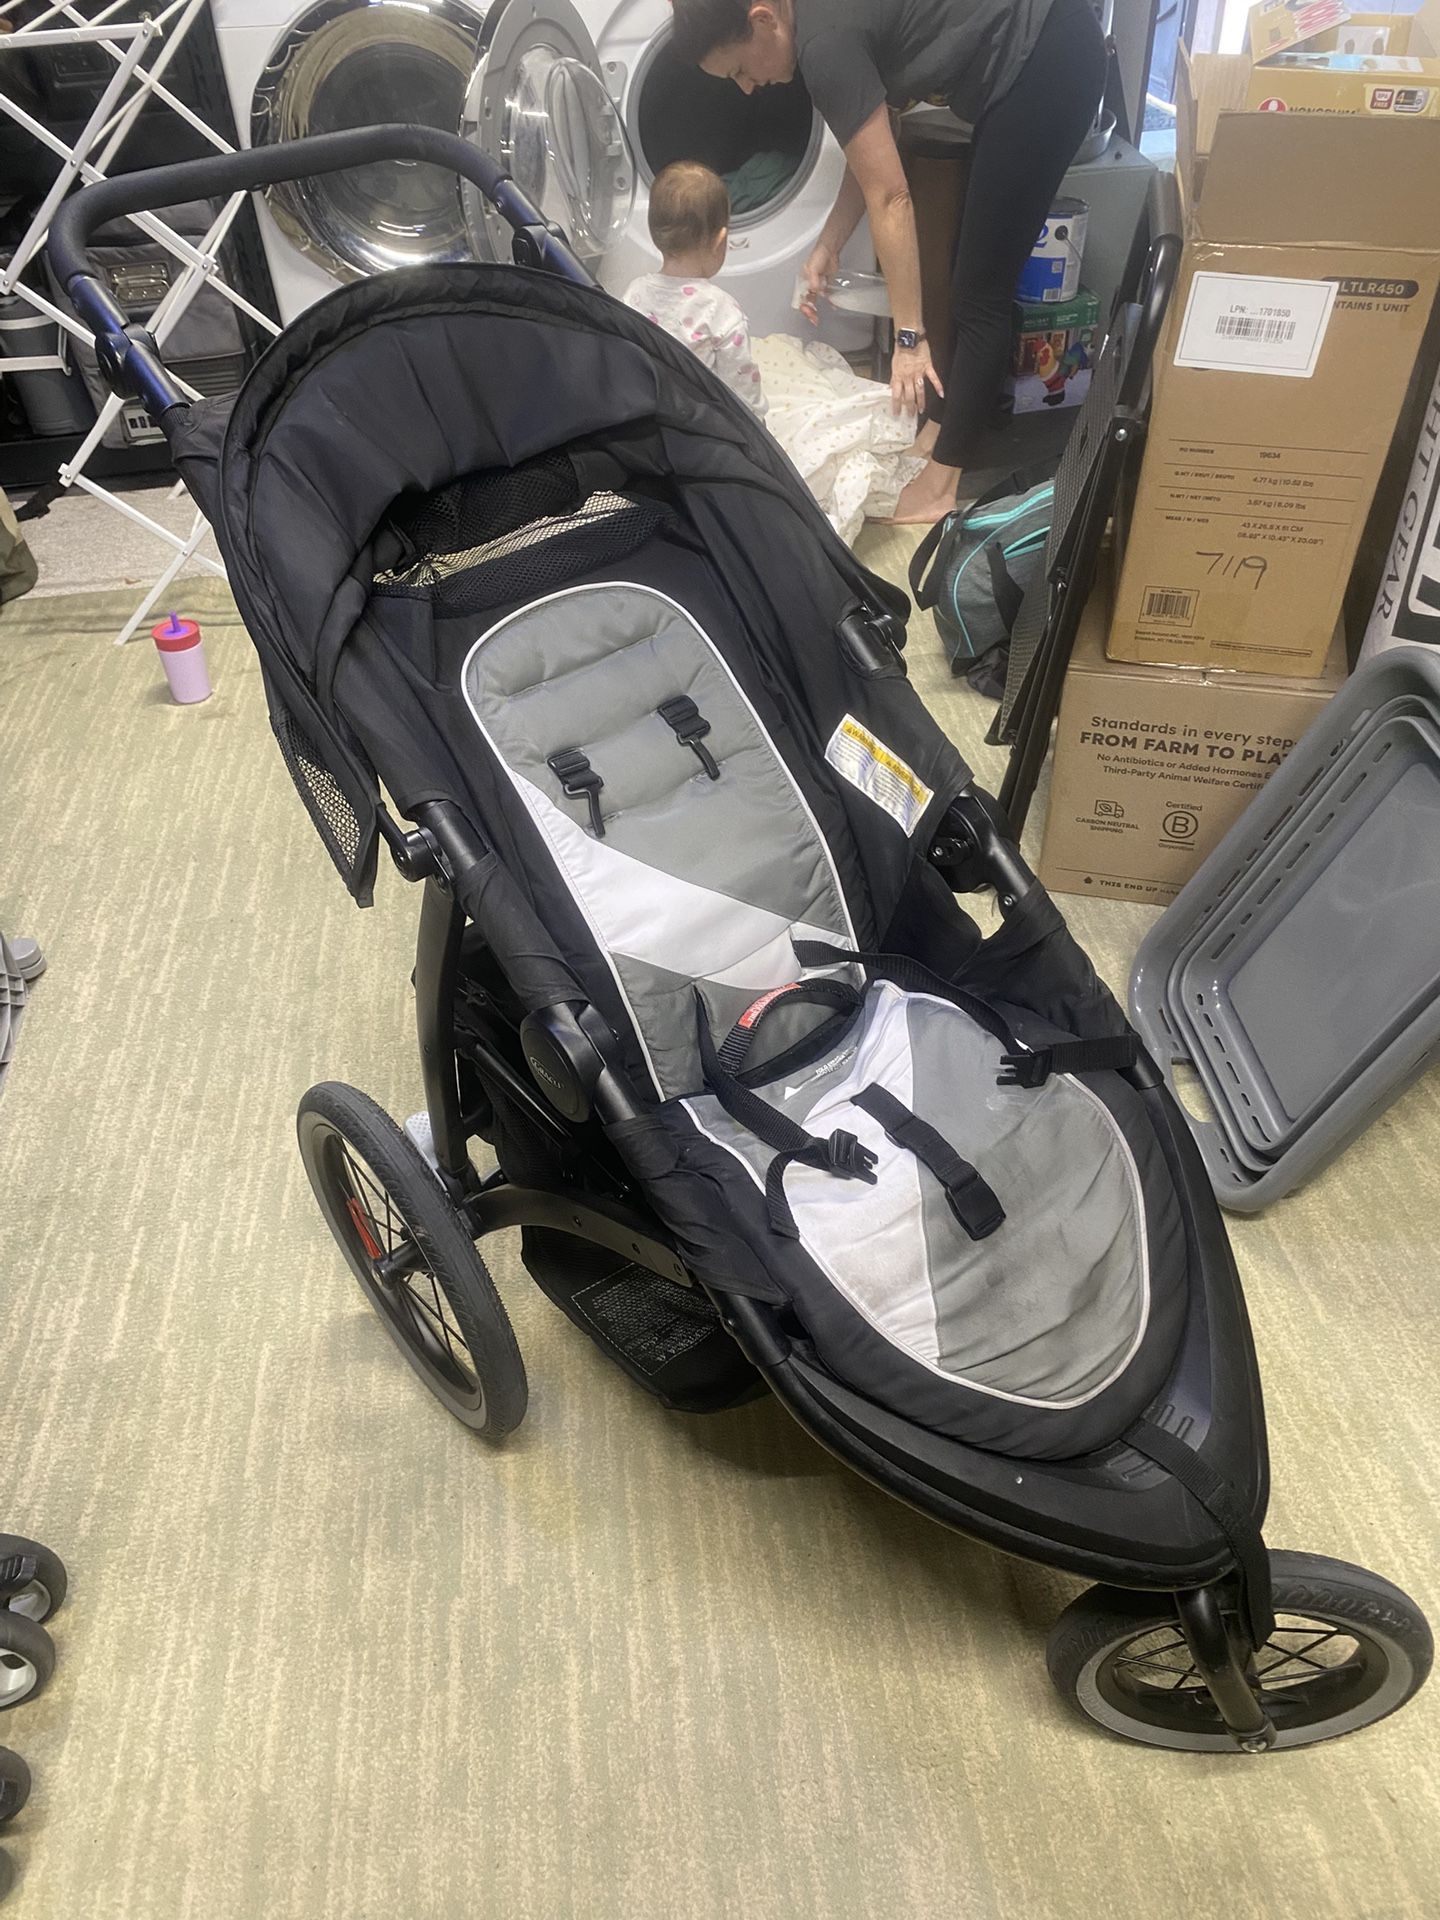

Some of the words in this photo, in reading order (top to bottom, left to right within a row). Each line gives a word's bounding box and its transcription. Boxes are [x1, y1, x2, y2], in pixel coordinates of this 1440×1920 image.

[1340, 281, 1405, 295] LTLR450
[1383, 303, 1411, 313] UNIT
[1290, 525, 1304, 533] CM
[1376, 490, 1418, 621] GEAR
[1091, 716, 1177, 736] Standards
[1182, 725, 1198, 738] in
[1203, 729, 1252, 746] every
[1080, 732, 1138, 750] FROM
[1143, 738, 1200, 756] FARM
[1206, 745, 1235, 760] TO
[1097, 753, 1111, 762] No
[1112, 755, 1165, 767] Antibiotics
[1166, 761, 1177, 769] or
[1179, 762, 1211, 773] Added
[1212, 765, 1263, 779] Hormones
[1103, 766, 1156, 780] Third-Party
[1158, 772, 1191, 783] Animal
[1192, 775, 1231, 788] Welfare
[1166, 801, 1203, 812] Certified
[1075, 816, 1107, 826] CARBON
[1107, 821, 1140, 830] NEUTRAL
[1171, 816, 1189, 834] B
[1100, 880, 1121, 889] THIS
[1124, 883, 1143, 891] END
